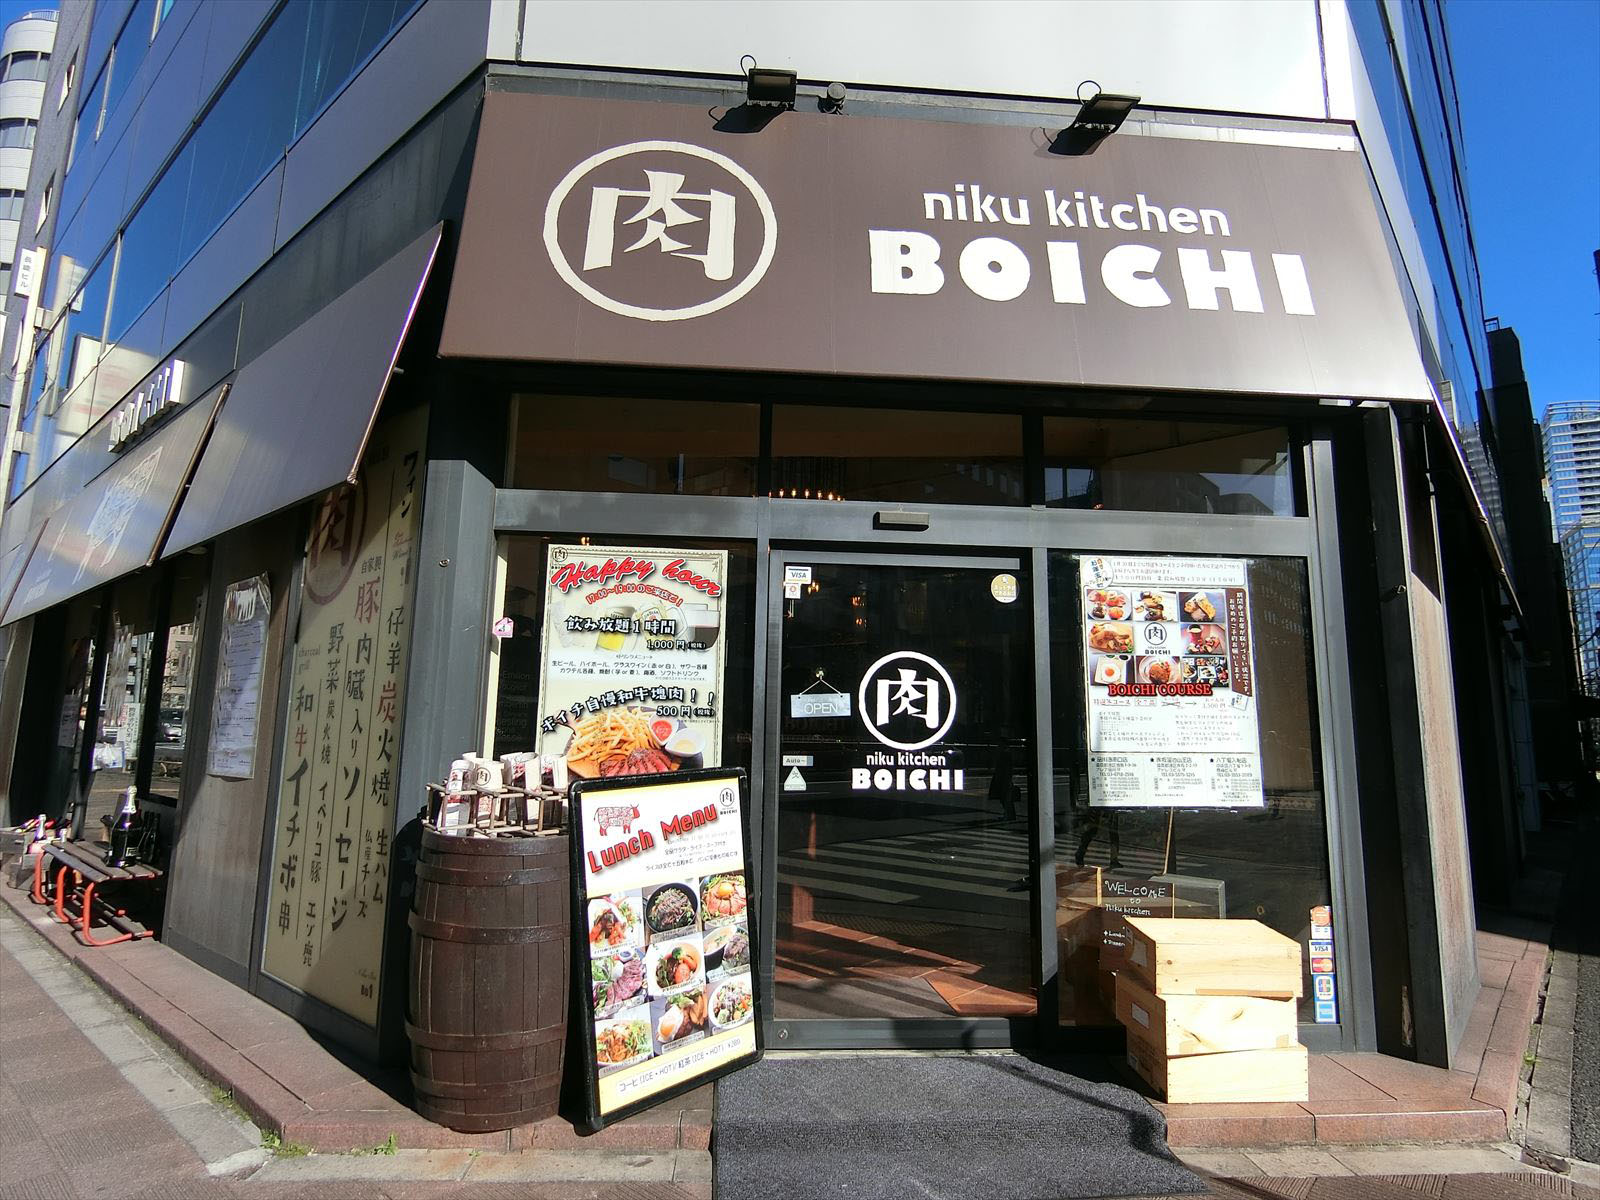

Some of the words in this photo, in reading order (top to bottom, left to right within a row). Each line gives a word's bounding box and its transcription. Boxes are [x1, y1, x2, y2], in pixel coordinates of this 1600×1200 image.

[923, 184, 1031, 226] niku
[1044, 190, 1231, 237] kitchen
[868, 229, 1316, 316] BOICHI
[400, 451, 419, 518] ワイン
[550, 556, 656, 593] Happy
[661, 558, 722, 597] hour
[1108, 684, 1156, 696] BOICHI
[1158, 684, 1213, 697] COURSE
[656, 705, 678, 716] 500
[803, 702, 839, 714] OPEN
[866, 752, 894, 766] niku
[897, 752, 946, 766] kitchen
[851, 768, 964, 791] BOICHI
[587, 829, 655, 874] Lunch
[660, 803, 718, 841] Menu
[373, 829, 388, 904] 生ハム
[1104, 880, 1166, 898] WELCOME
